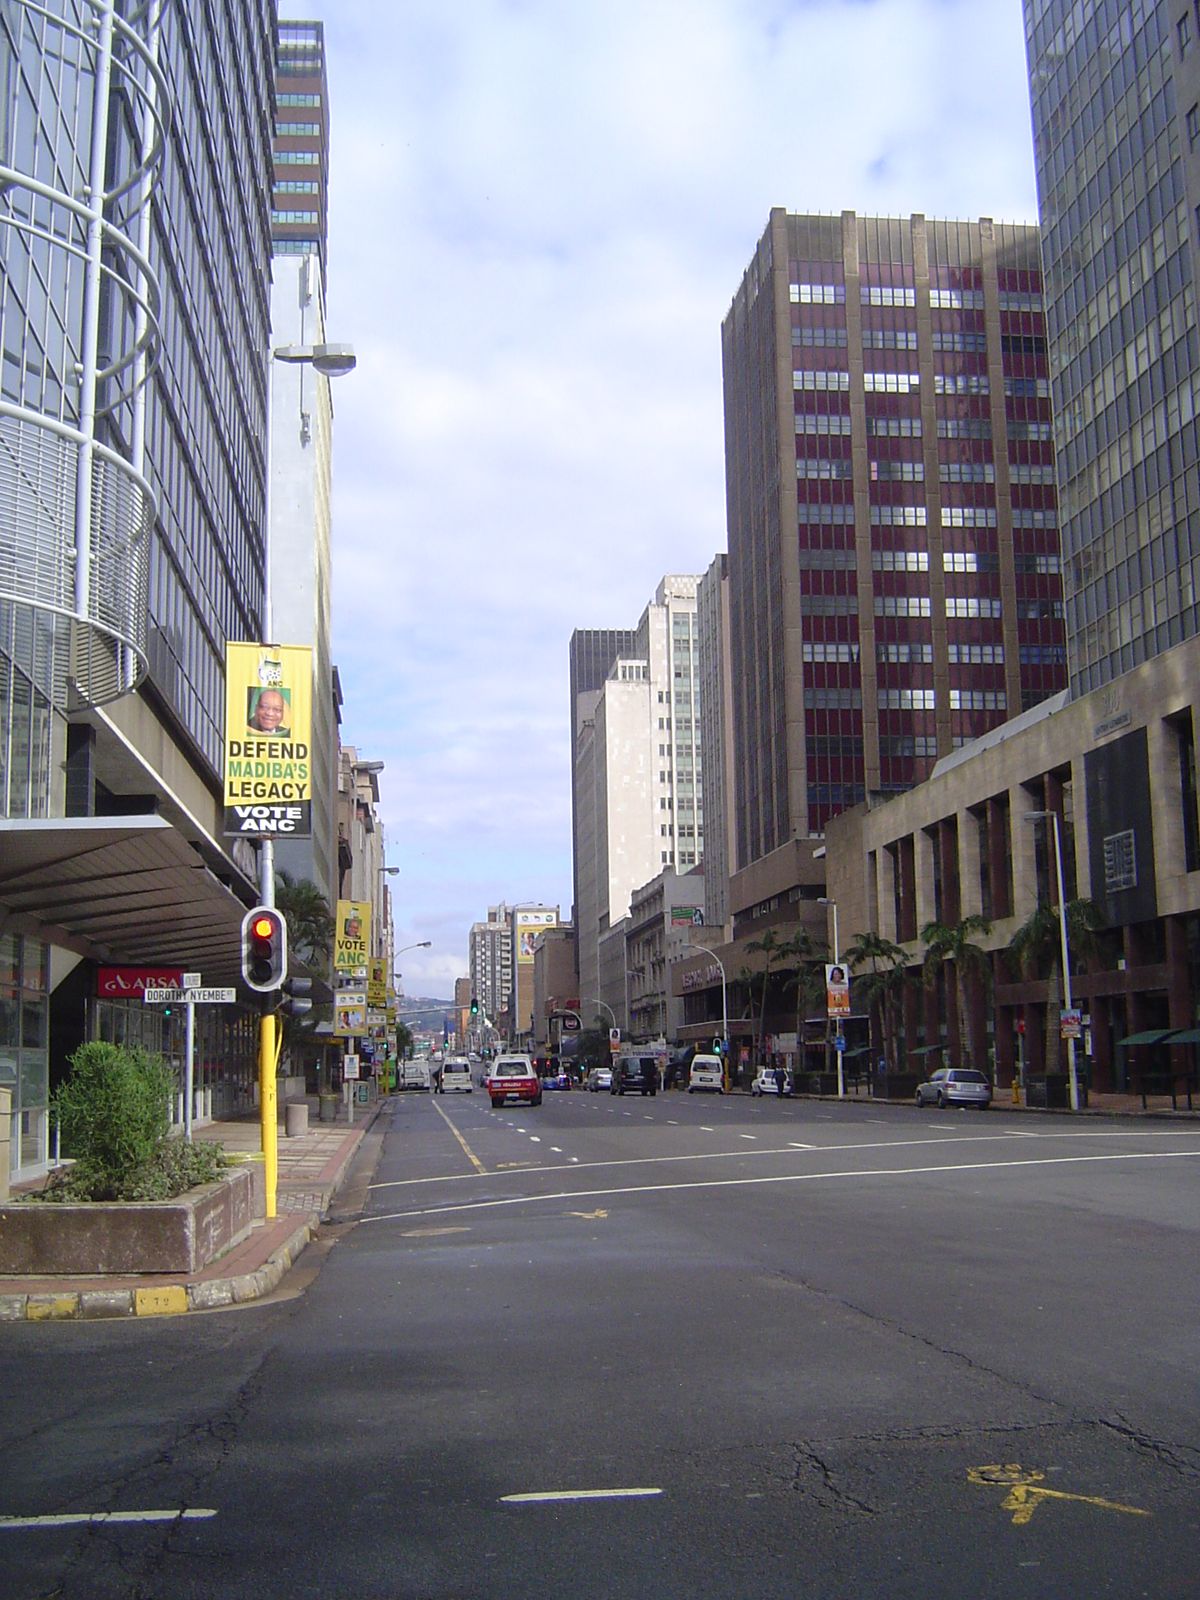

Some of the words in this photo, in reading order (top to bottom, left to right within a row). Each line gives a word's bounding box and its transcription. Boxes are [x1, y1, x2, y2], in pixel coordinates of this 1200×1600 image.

[229, 741, 308, 759] DEFEND
[229, 761, 308, 779] MADIBA'S
[229, 781, 307, 799] LEGACY
[234, 806, 302, 819] VOTE
[241, 819, 295, 831] ANC
[337, 940, 366, 951] VOTE
[336, 951, 365, 964] ANC
[132, 977, 179, 989] ABSA
[147, 990, 187, 1001] DOROTHY
[190, 990, 226, 1000] NYEMBE
